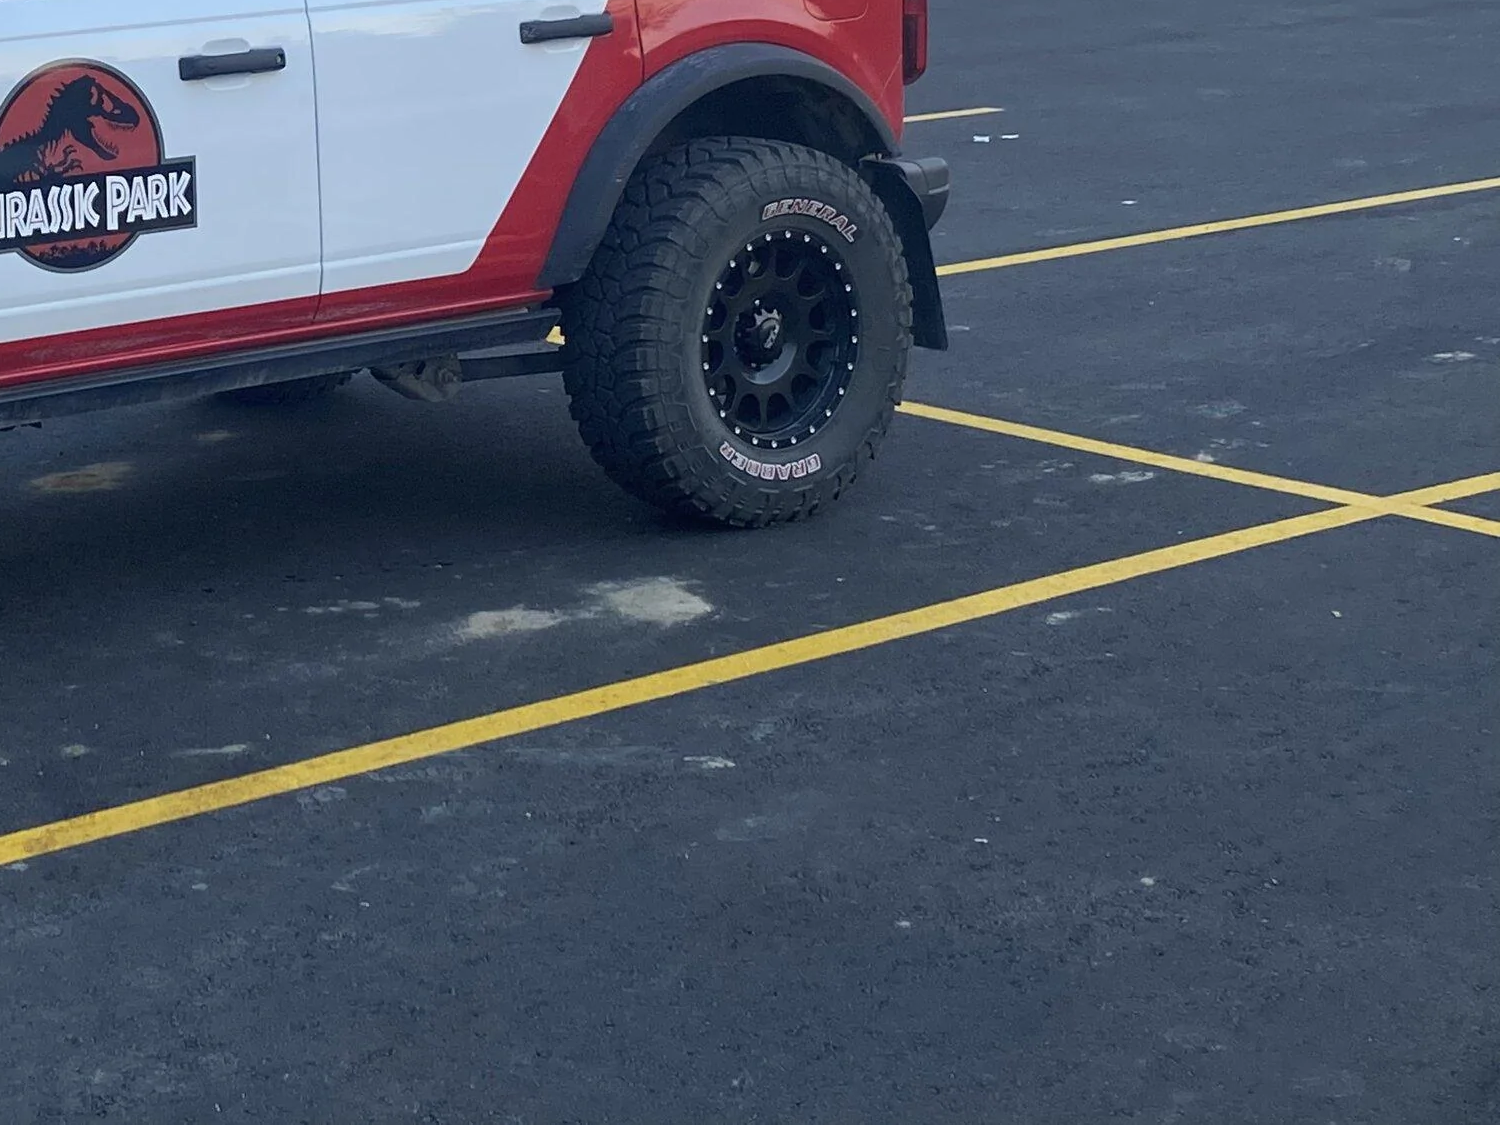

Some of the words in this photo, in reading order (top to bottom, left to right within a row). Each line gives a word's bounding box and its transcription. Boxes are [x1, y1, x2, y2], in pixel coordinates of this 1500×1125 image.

[104, 170, 194, 230] PARK
[762, 198, 858, 243] GENERAL
[719, 440, 822, 481] GRABBER
